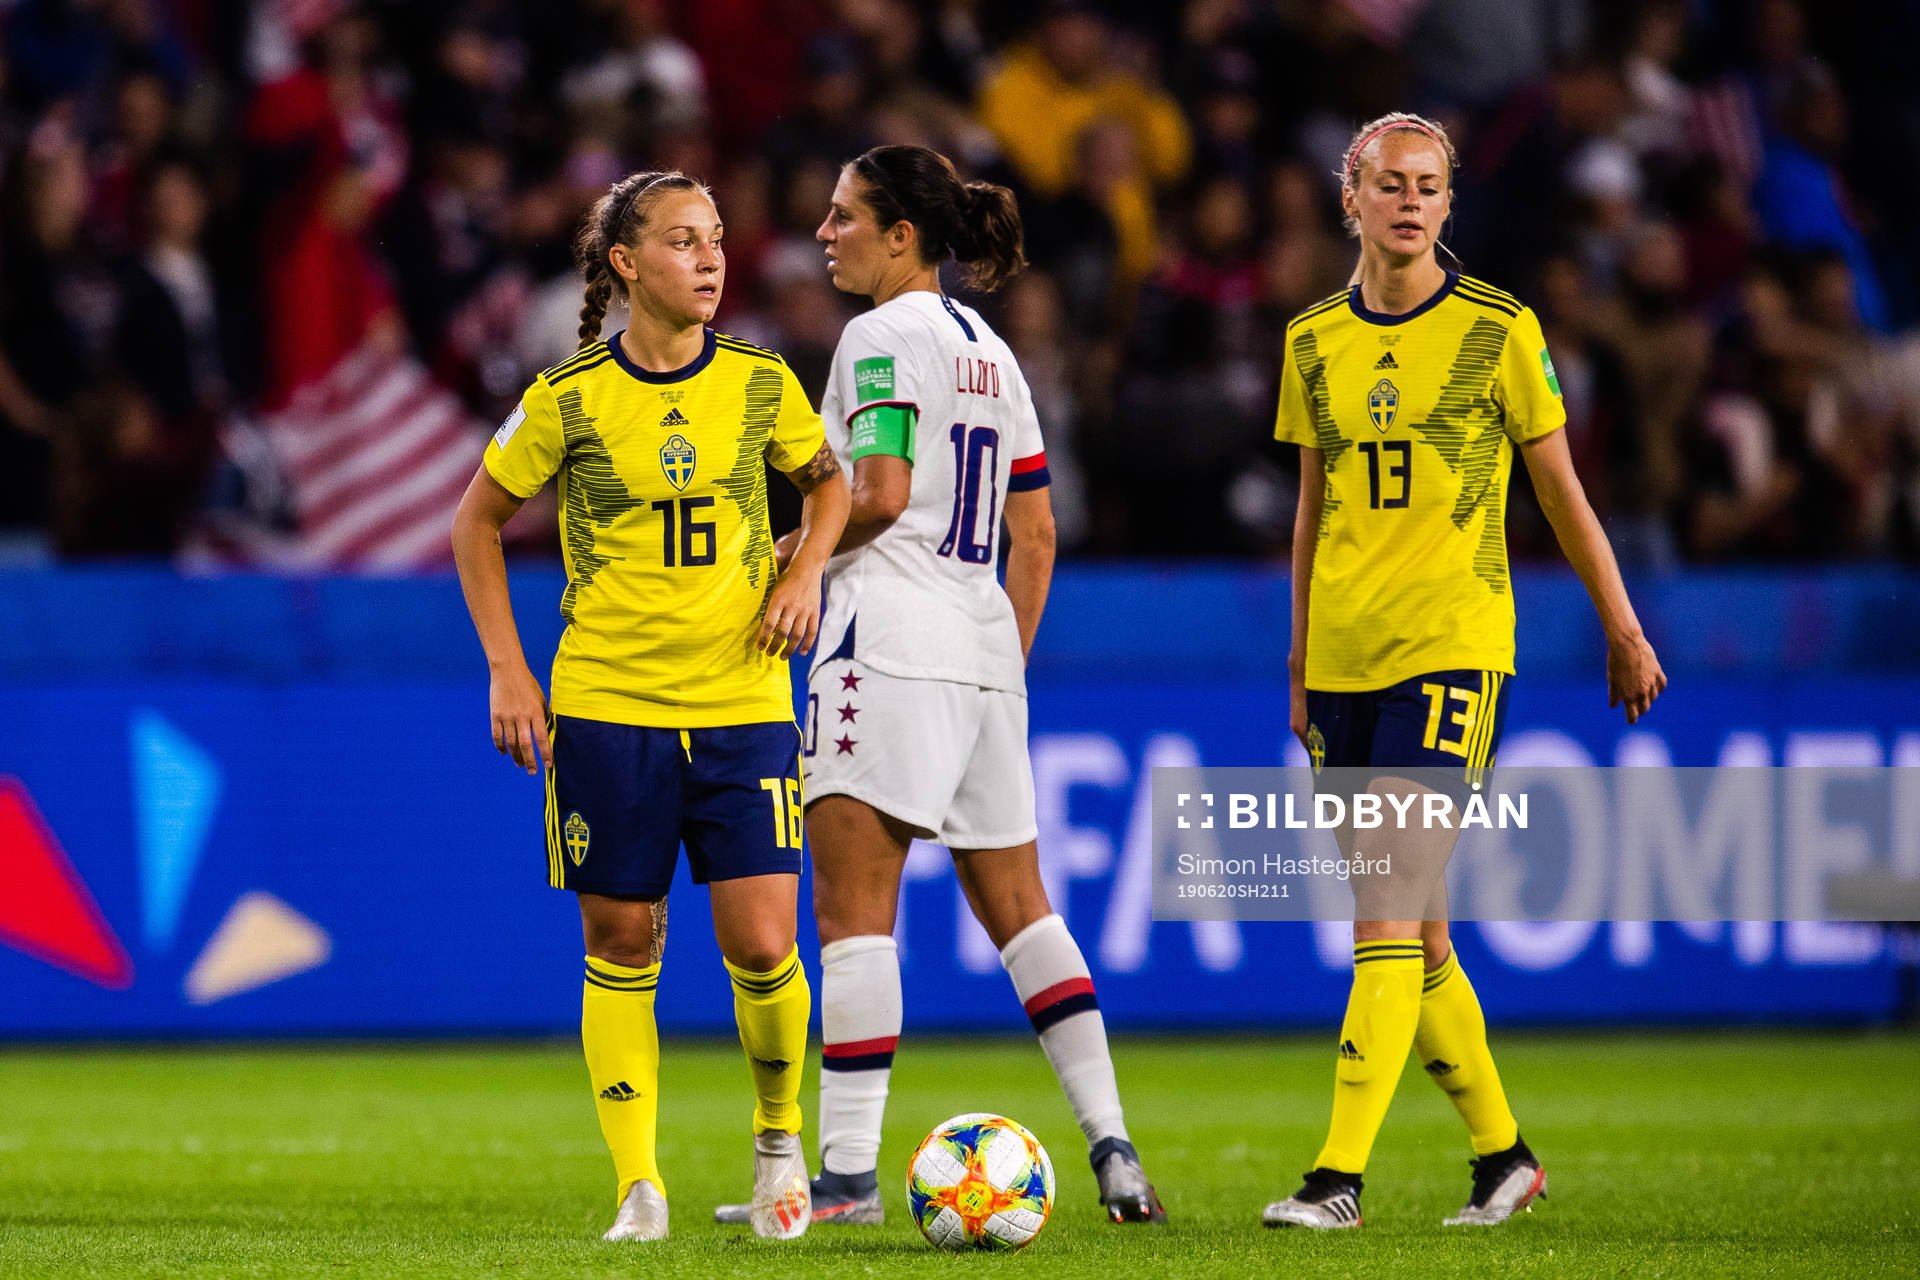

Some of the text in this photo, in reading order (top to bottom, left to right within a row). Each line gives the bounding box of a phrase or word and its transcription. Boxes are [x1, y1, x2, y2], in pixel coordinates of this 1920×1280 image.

[957, 357, 999, 398] LLOYD
[937, 423, 999, 564] 10
[1358, 440, 1412, 509] 13
[652, 496, 717, 567] 16
[1422, 682, 1481, 758] 13
[760, 777, 803, 849] 16
